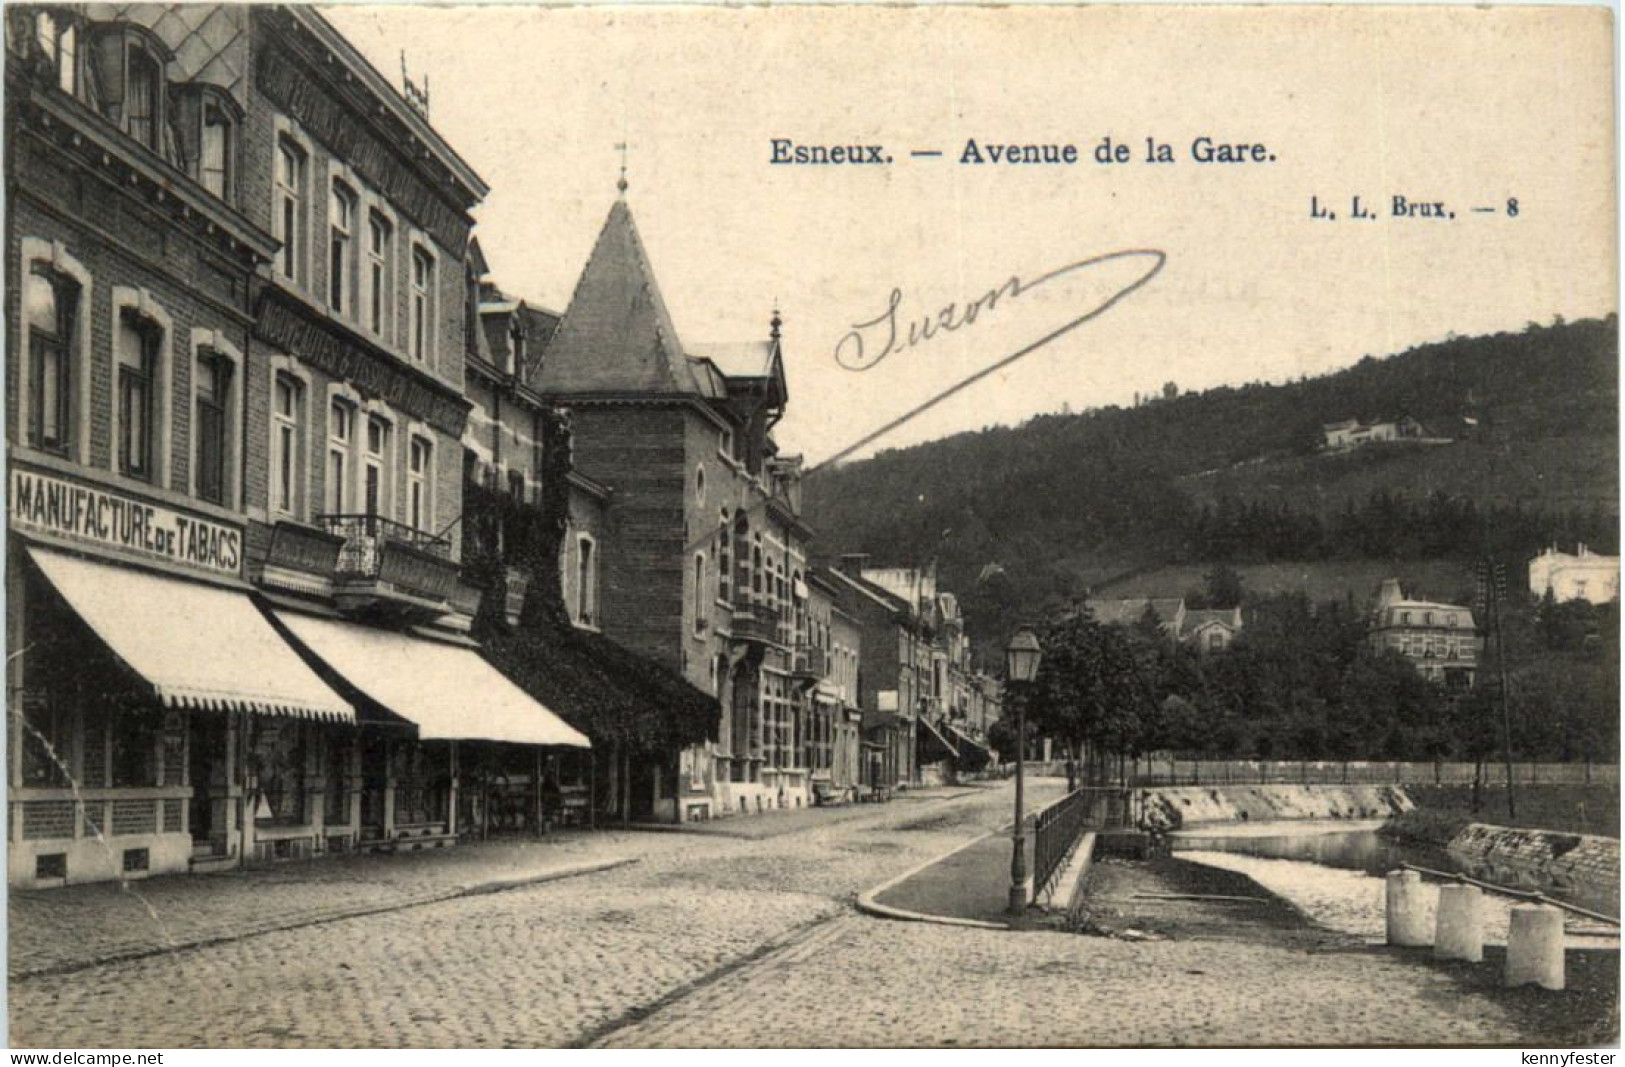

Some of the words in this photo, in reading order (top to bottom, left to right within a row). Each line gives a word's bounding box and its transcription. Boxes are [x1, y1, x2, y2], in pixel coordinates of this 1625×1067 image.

[16, 474, 154, 550] MANUFACTURE
[155, 527, 176, 554] DE
[176, 517, 238, 569] TABACS
